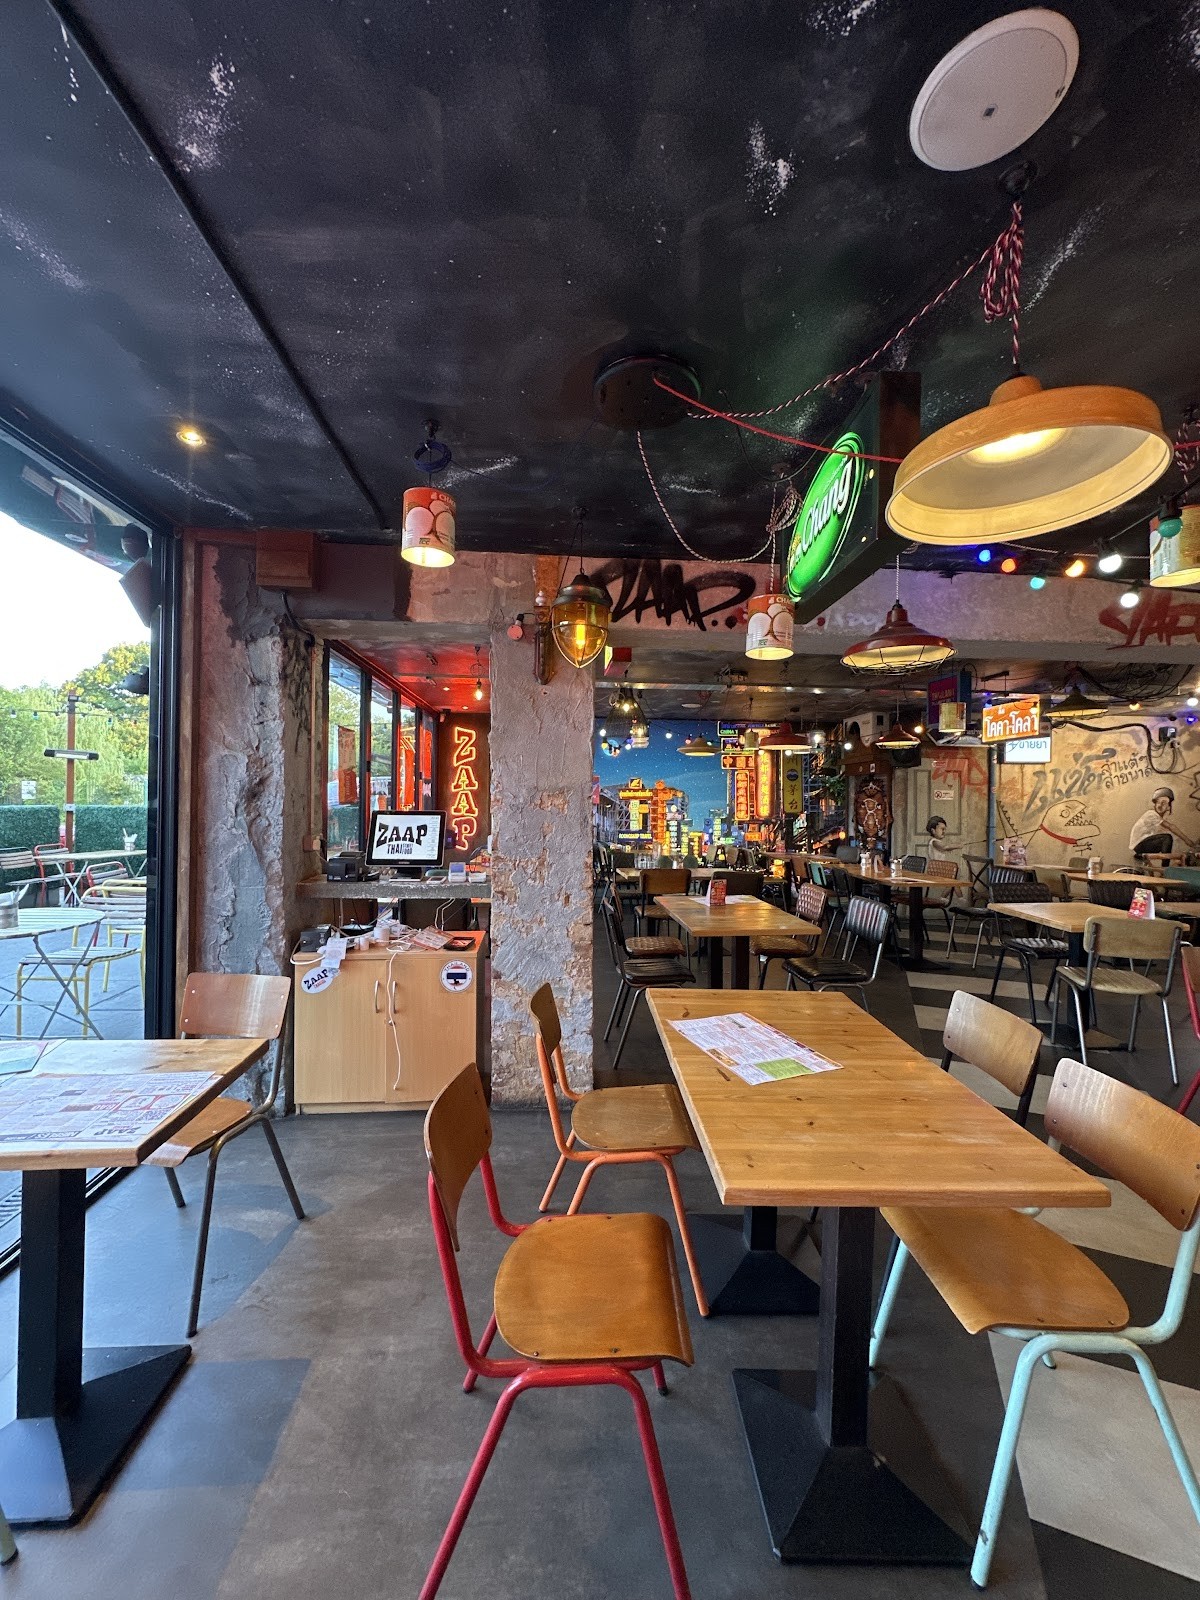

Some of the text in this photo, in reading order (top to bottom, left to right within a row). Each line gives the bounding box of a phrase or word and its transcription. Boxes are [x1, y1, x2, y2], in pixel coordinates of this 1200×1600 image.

[802, 456, 853, 552] Chang
[452, 726, 478, 851] ZAAP
[376, 823, 428, 848] ZAAP
[387, 843, 403, 855] THAI
[303, 969, 329, 990] ZAAP
